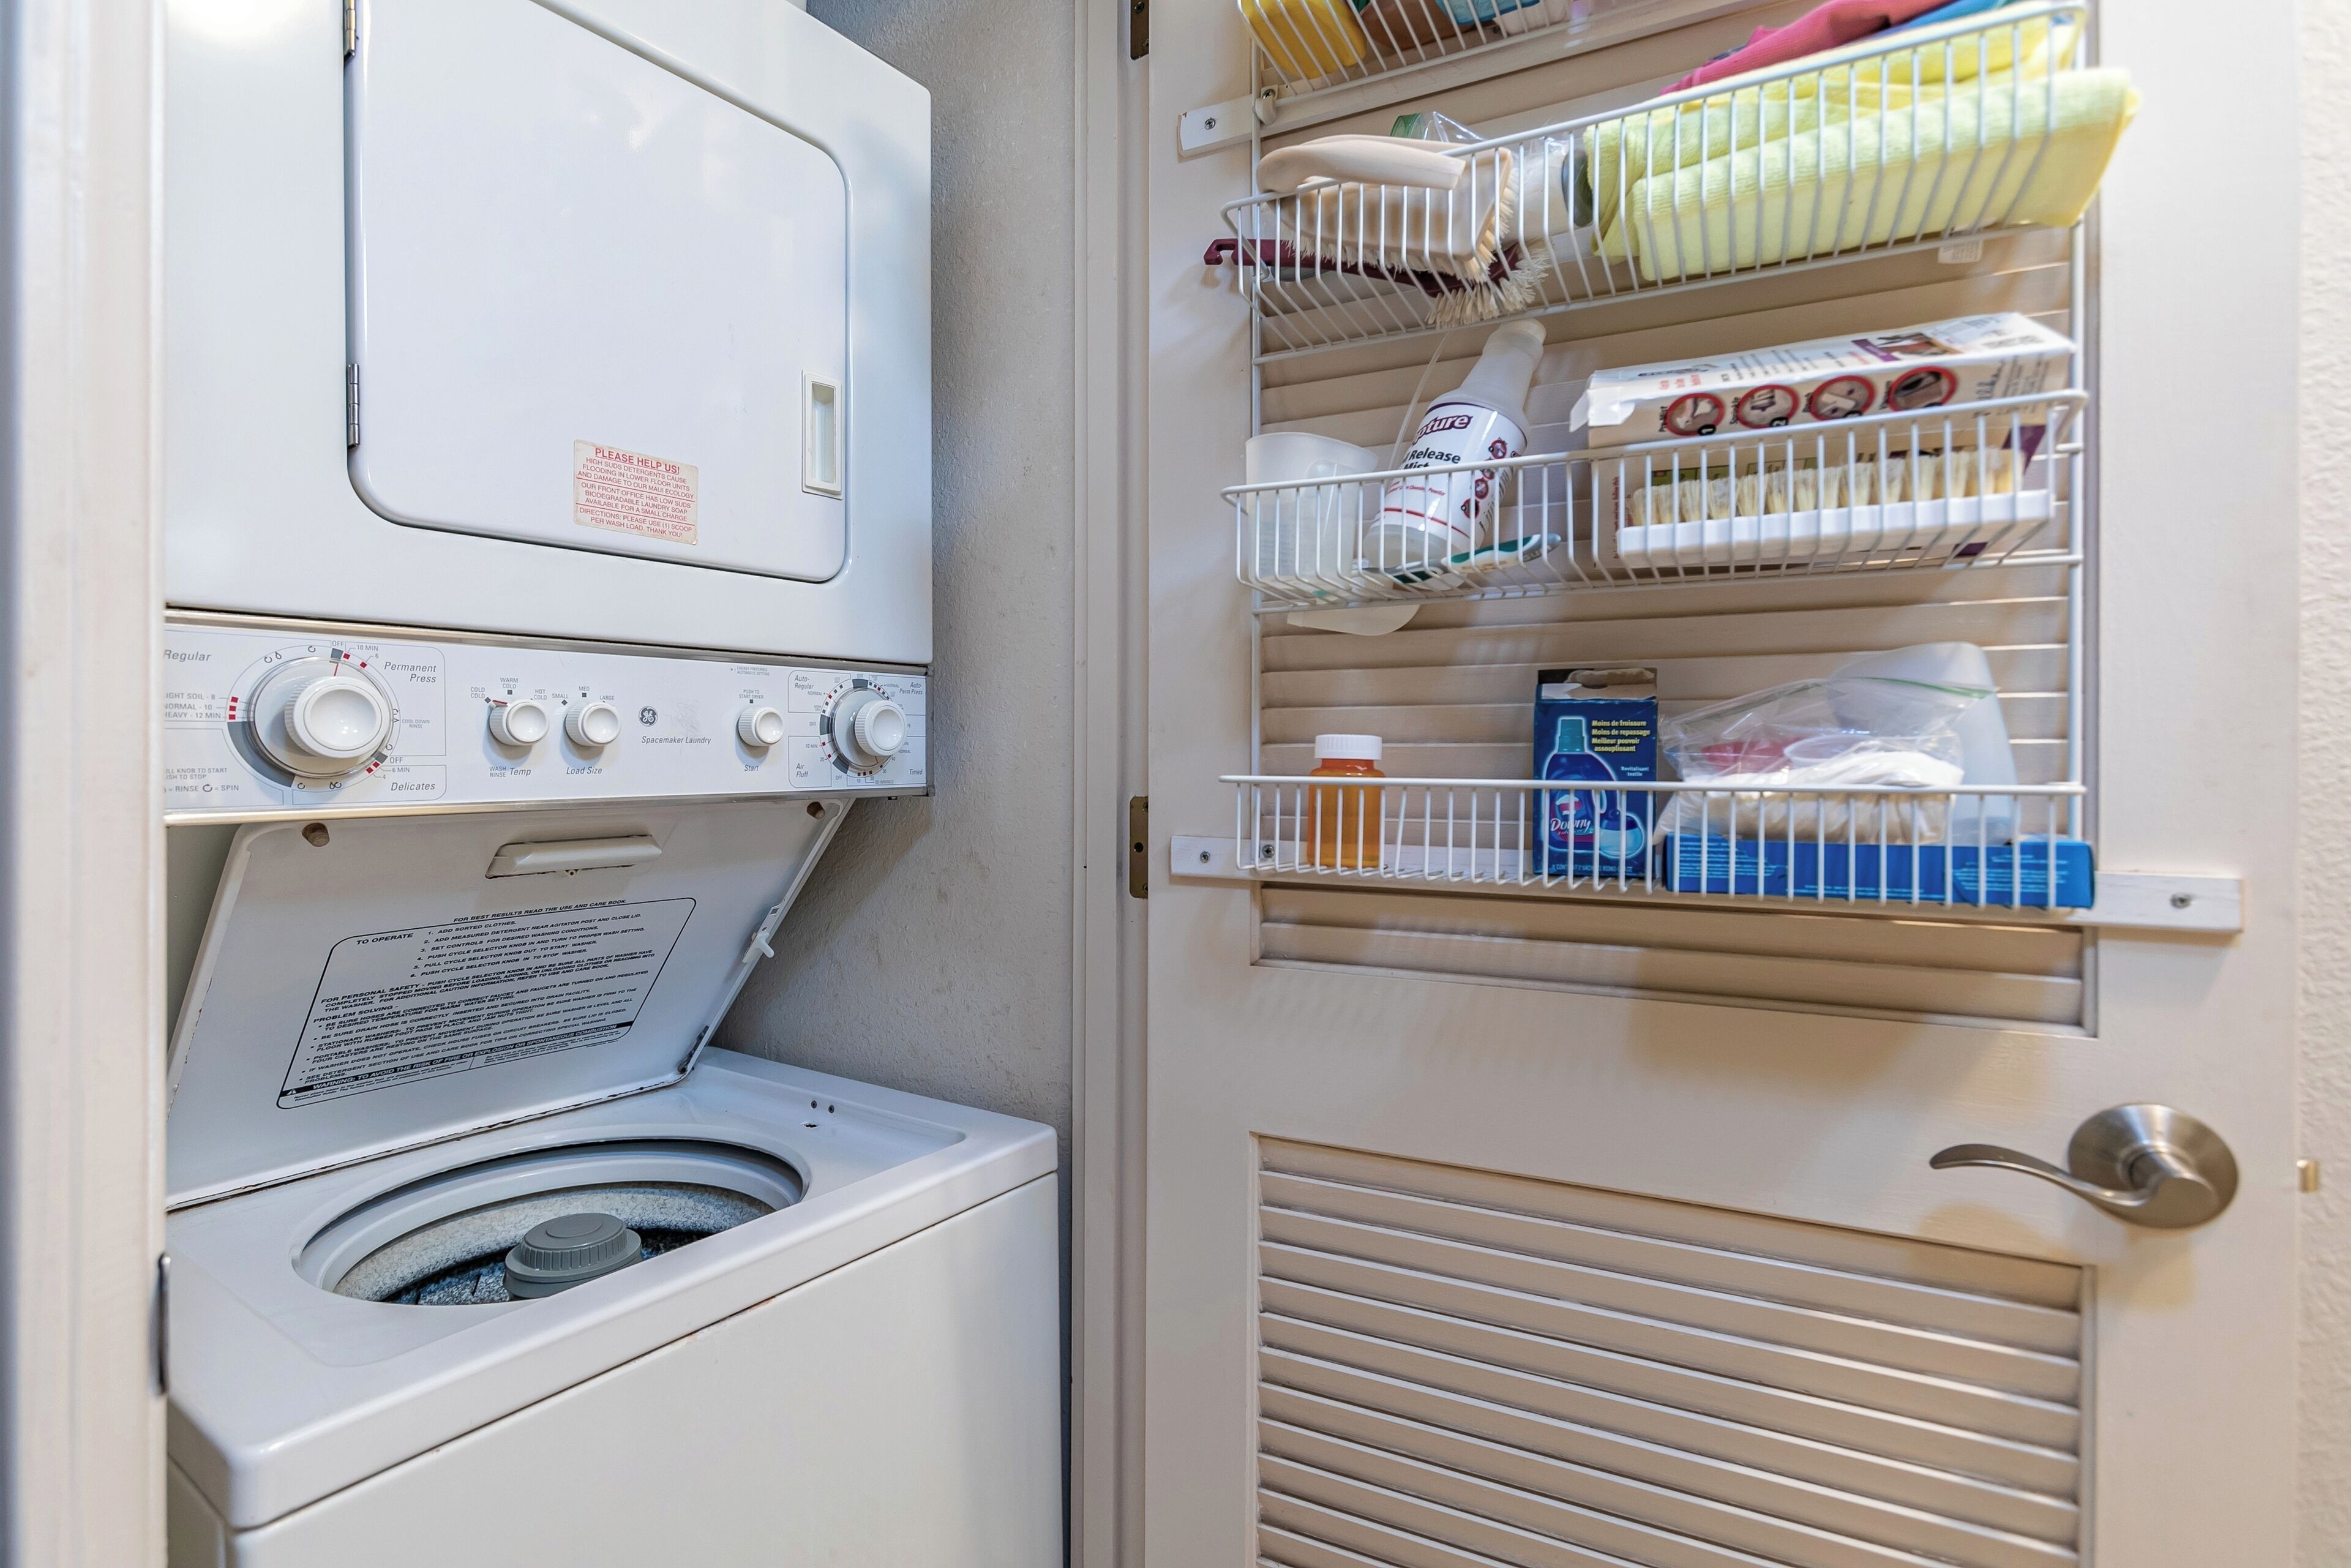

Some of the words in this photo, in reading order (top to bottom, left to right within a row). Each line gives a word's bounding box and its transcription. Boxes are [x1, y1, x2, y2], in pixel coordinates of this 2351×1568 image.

[595, 448, 634, 463] PLEASE
[637, 457, 661, 470] HELP
[664, 463, 680, 474] US!
[1409, 448, 1461, 463] Release
[582, 463, 616, 476] FLOODING
[626, 473, 648, 483] LOWER
[650, 478, 670, 487] FLOOR
[672, 482, 689, 492] UNITS
[586, 457, 602, 465] HIGH
[604, 460, 622, 470] SUDS
[623, 465, 665, 479] DETERGENTS
[666, 475, 686, 484] CAUSE
[577, 470, 591, 479] AND
[593, 473, 621, 484] DAMAGE
[648, 484, 663, 493] MAUI
[665, 488, 694, 499] ECOLOGY
[581, 481, 596, 490] OUR
[598, 485, 620, 495] FRONT
[621, 489, 644, 499] OFFICE
[675, 500, 691, 509] SUDS
[585, 489, 639, 506] BIODEGRADABLE
[641, 500, 670, 511] LAUNDRY
[671, 506, 687, 515] SOAP
[585, 497, 620, 509] AVAILABLE
[641, 508, 661, 517] SMALL
[662, 512, 687, 522] CHARGE
[579, 506, 621, 520] DIRECTIONS:
[623, 514, 647, 525] PLEASE
[671, 523, 692, 533] SCOOP
[606, 519, 624, 528] WASH
[626, 522, 645, 531] LOAD.
[646, 526, 667, 535] THANK
[163, 650, 212, 662] Regular
[384, 661, 437, 672] Permanent
[410, 673, 437, 683] Press
[642, 736, 684, 745] Spacemaker
[685, 736, 711, 745] Laundry
[510, 767, 531, 777] Temp
[391, 782, 436, 791] Delicates
[370, 932, 414, 943] OPERATE
[313, 1011, 356, 1023] PROBLEM
[357, 1005, 394, 1016] SOLVING
[312, 1076, 356, 1090] WARNING:
[369, 1068, 396, 1078] AVOID
[473, 1045, 514, 1057] EXPLOSION
[525, 1032, 575, 1046] SPONTANEOUS
[574, 1024, 618, 1036] COMBUSTION
